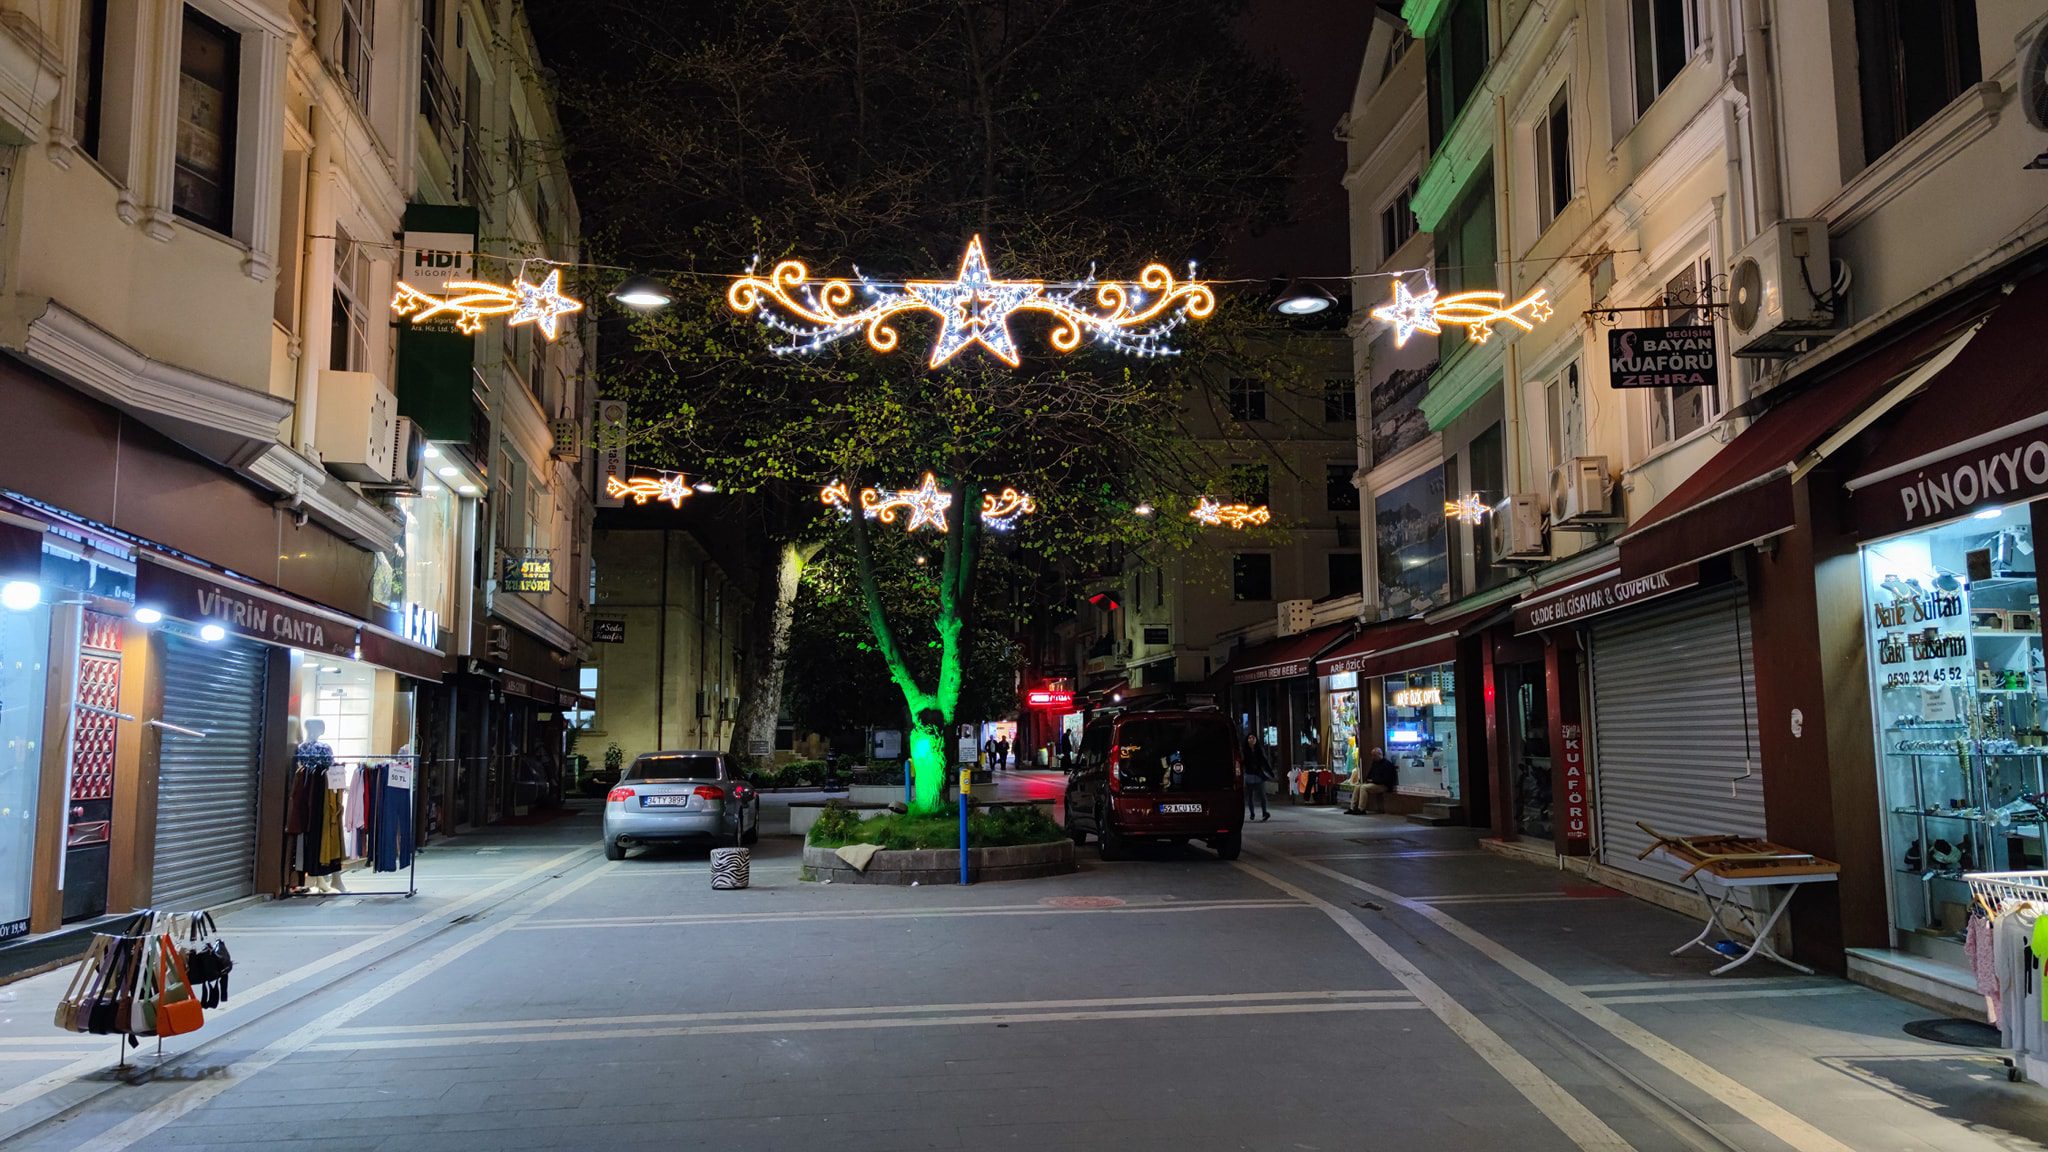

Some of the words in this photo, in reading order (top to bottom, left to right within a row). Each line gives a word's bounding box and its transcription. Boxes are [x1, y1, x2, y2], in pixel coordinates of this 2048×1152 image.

[416, 250, 461, 268] HDI
[1643, 338, 1712, 352] BAYAN
[1666, 329, 1712, 339] DEĞİŞİM
[1612, 351, 1713, 373] KUAFÖRÜ
[1622, 373, 1705, 386] ZEHRA
[1901, 440, 2048, 522] PİNOKYO
[197, 588, 268, 632] VİTRİN
[273, 613, 324, 647] ÇANTA
[1530, 608, 1554, 626] CADDE
[1555, 589, 1605, 619] BİLGİSAYAR
[1605, 587, 1615, 604] &
[1912, 591, 1963, 623] Sultan
[1887, 671, 1910, 685] 0530
[1913, 669, 1930, 684] 321
[1933, 668, 1946, 682] 45
[1949, 666, 1962, 680] 52
[1566, 740, 1584, 831] KUAFÖRÜ
